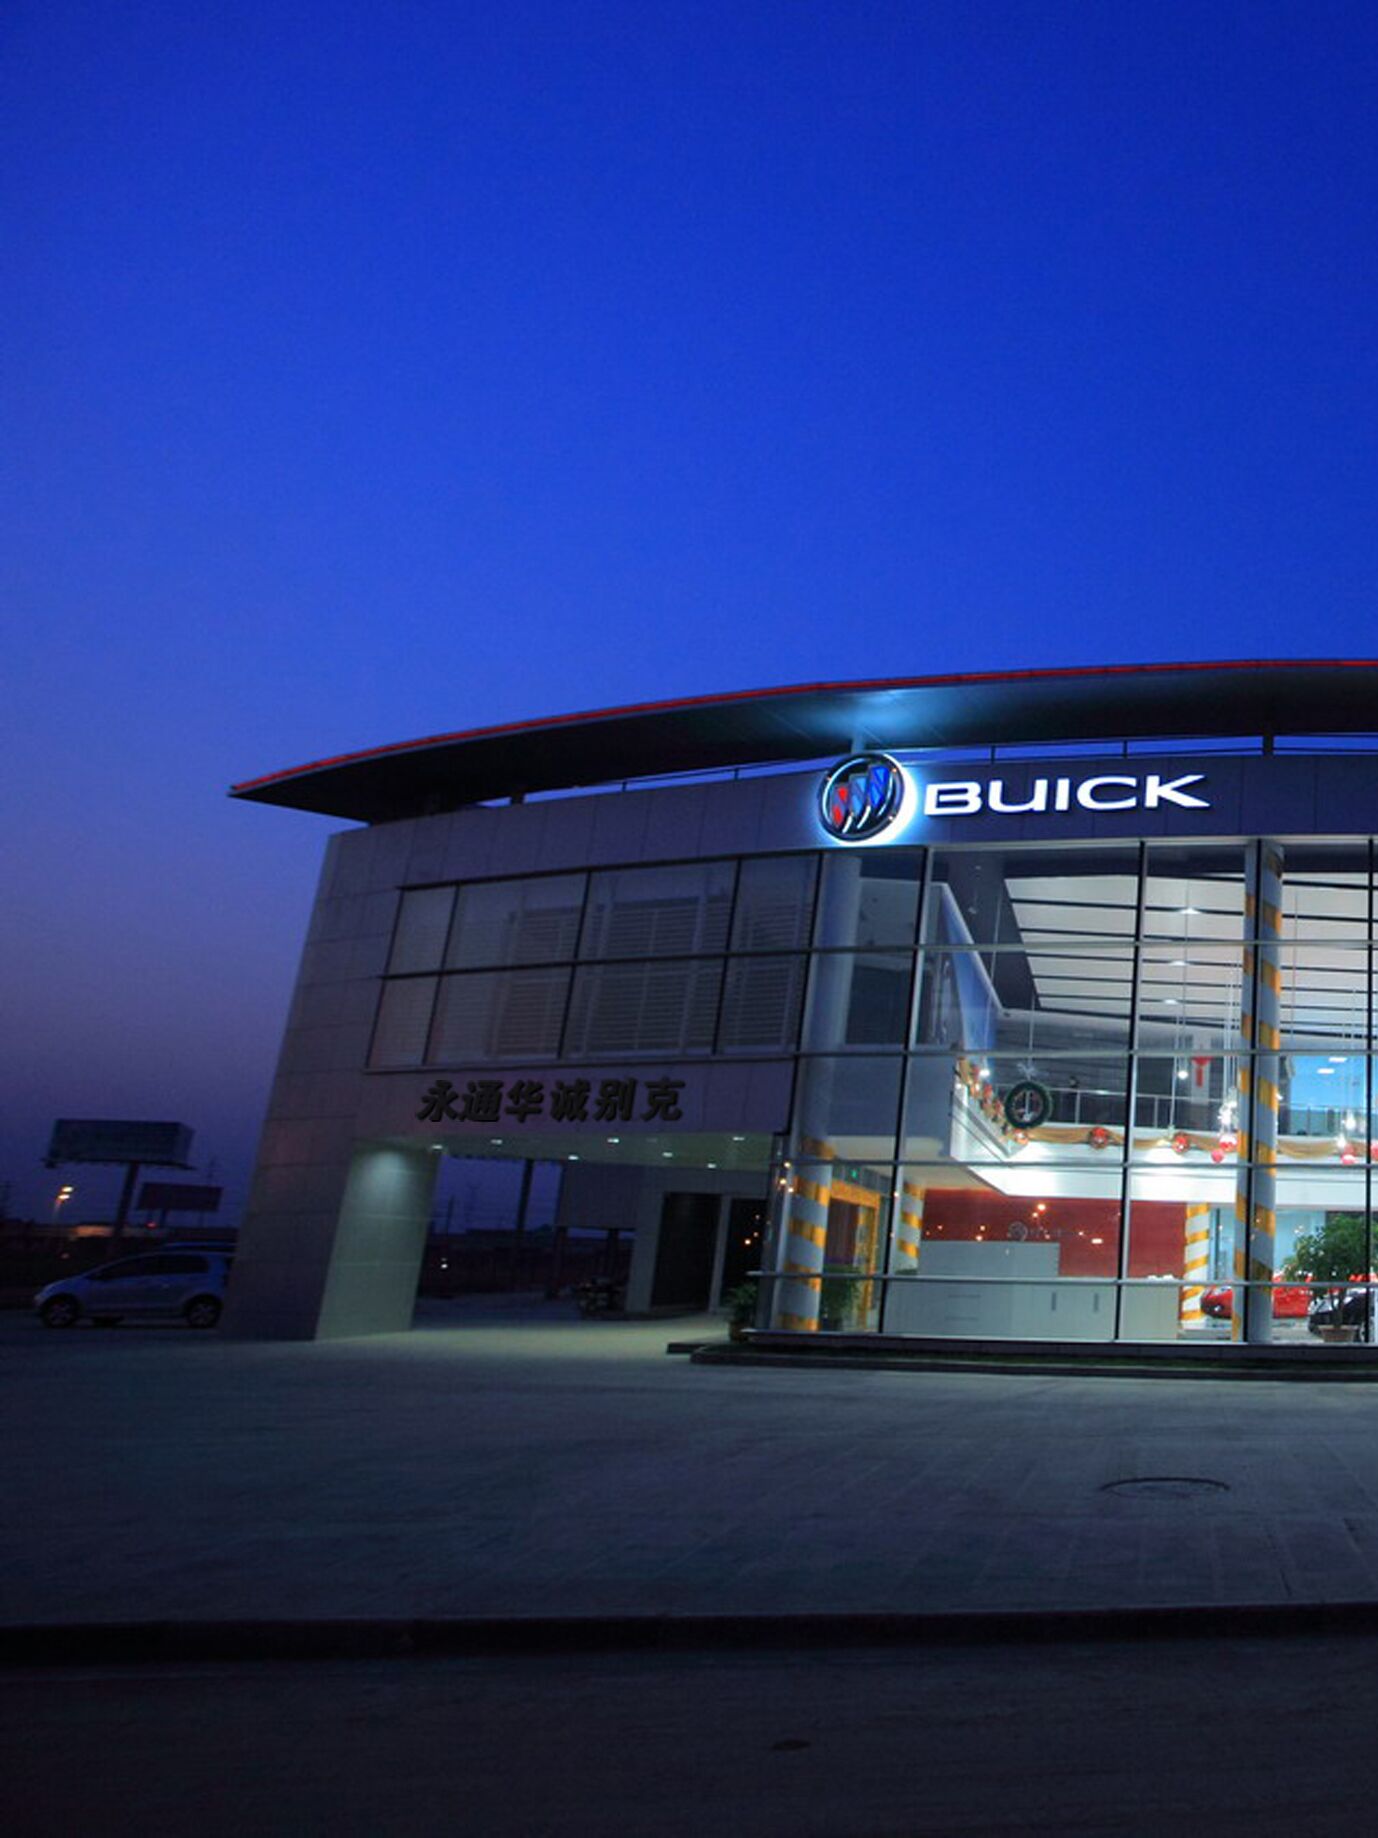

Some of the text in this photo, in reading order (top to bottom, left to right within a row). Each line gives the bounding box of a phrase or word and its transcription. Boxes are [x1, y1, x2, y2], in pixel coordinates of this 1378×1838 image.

[923, 774, 1211, 816] BUICK
[416, 1077, 686, 1123] 永通华诚别克
